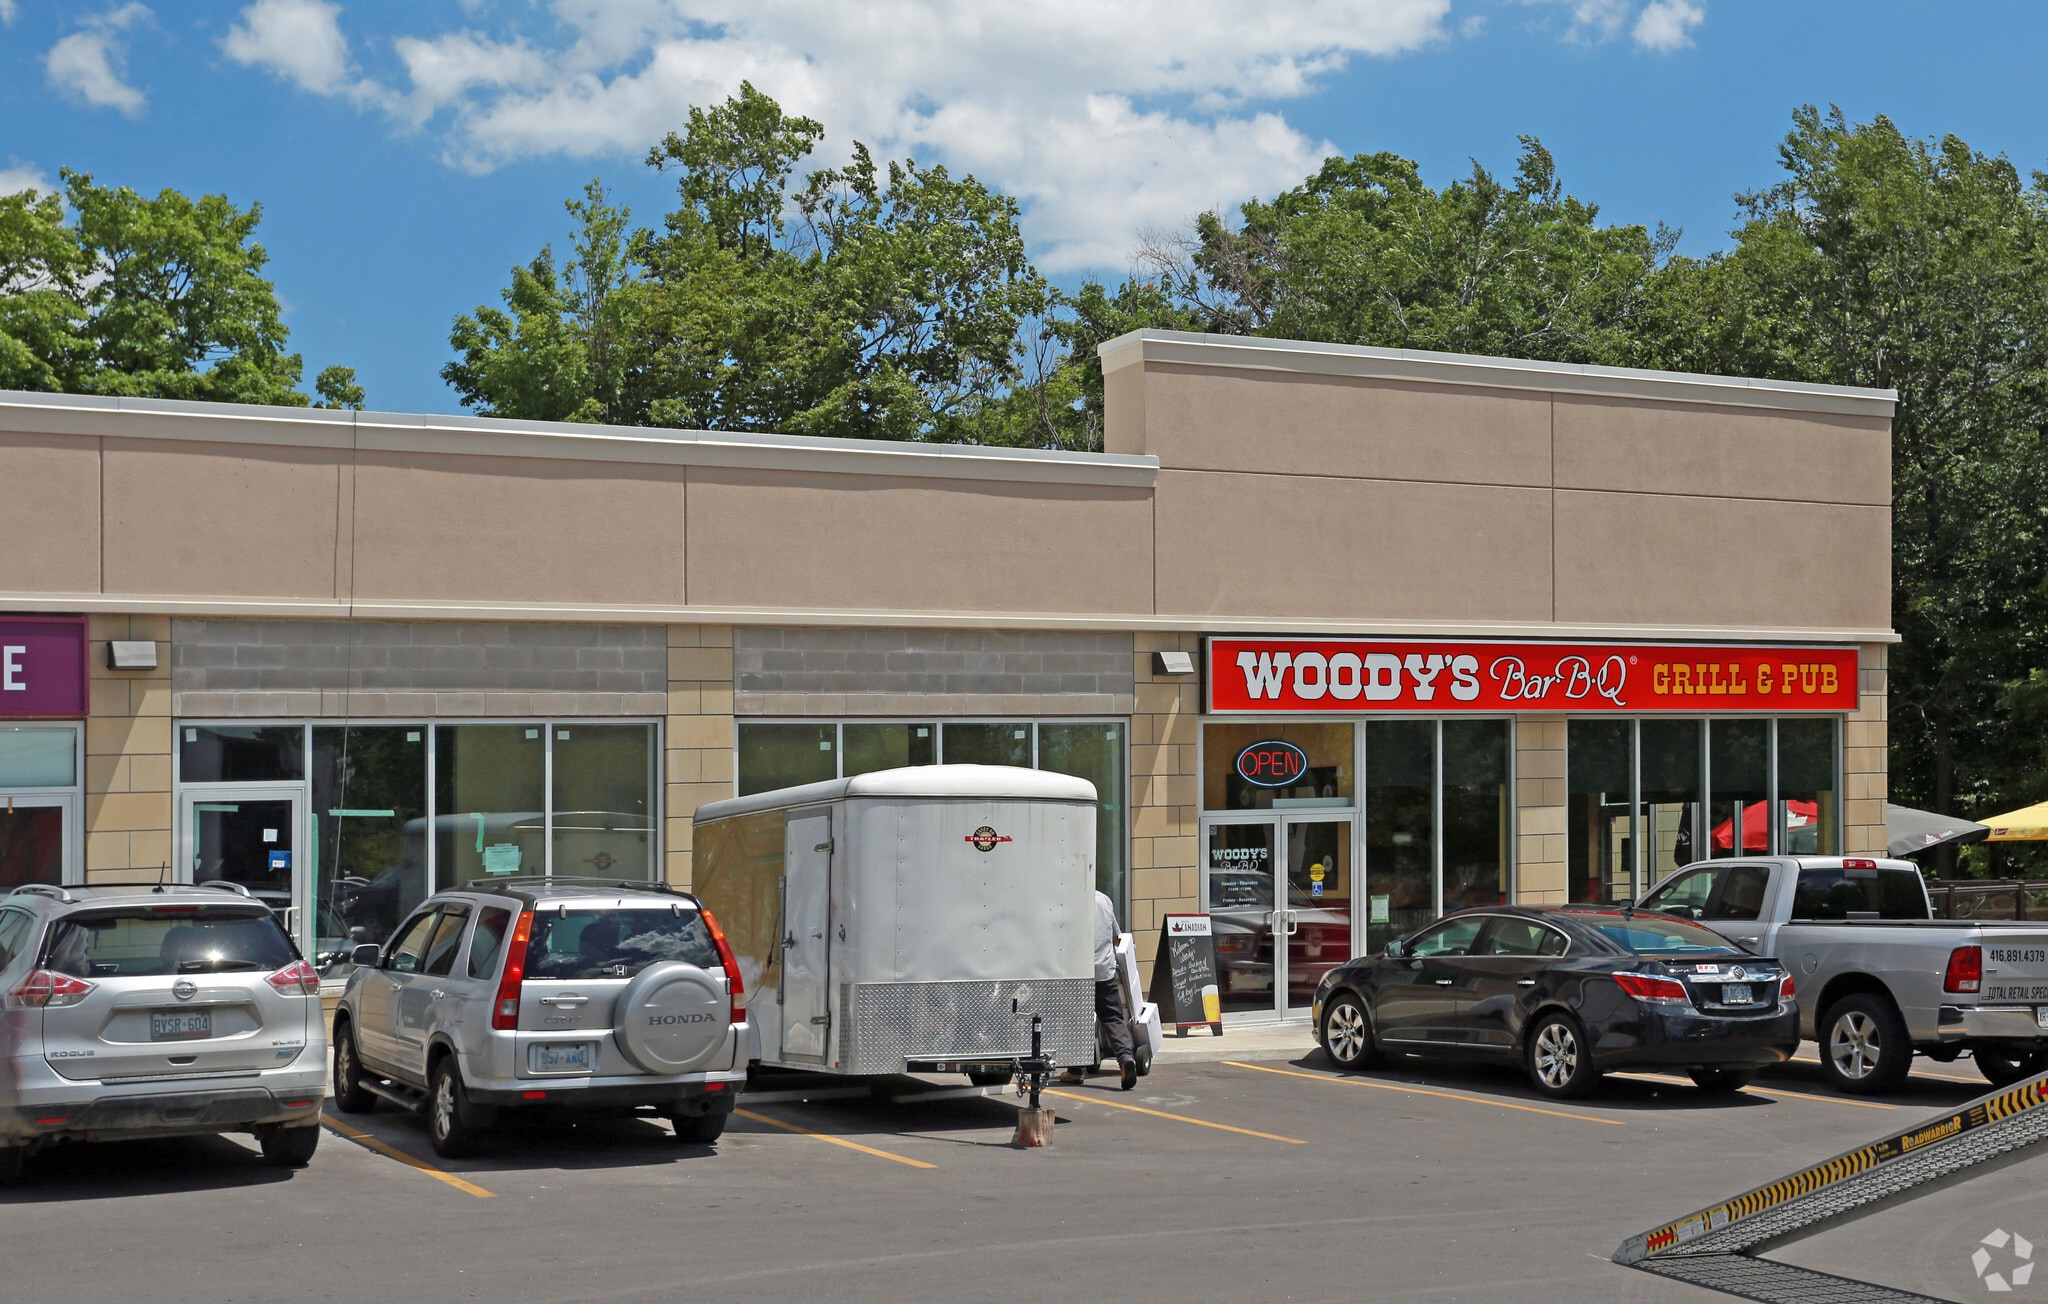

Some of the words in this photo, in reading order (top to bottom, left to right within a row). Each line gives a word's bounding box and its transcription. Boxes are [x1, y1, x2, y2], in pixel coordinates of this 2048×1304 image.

[1236, 650, 1481, 702] WOODY'S
[1653, 663, 1748, 695] GRILL
[1757, 662, 1775, 695] &
[1781, 664, 1840, 695] PUB
[1241, 751, 1300, 776] OPEN
[1211, 847, 1268, 861] WOODY'S
[1181, 922, 1207, 932] CANADIAN
[1990, 949, 2045, 962] 416.891.4379
[1988, 986, 2006, 999] TOTAL
[2008, 986, 2029, 999] RETAIL
[647, 1012, 716, 1026] HONDA
[50, 1049, 95, 1058] ROGUE
